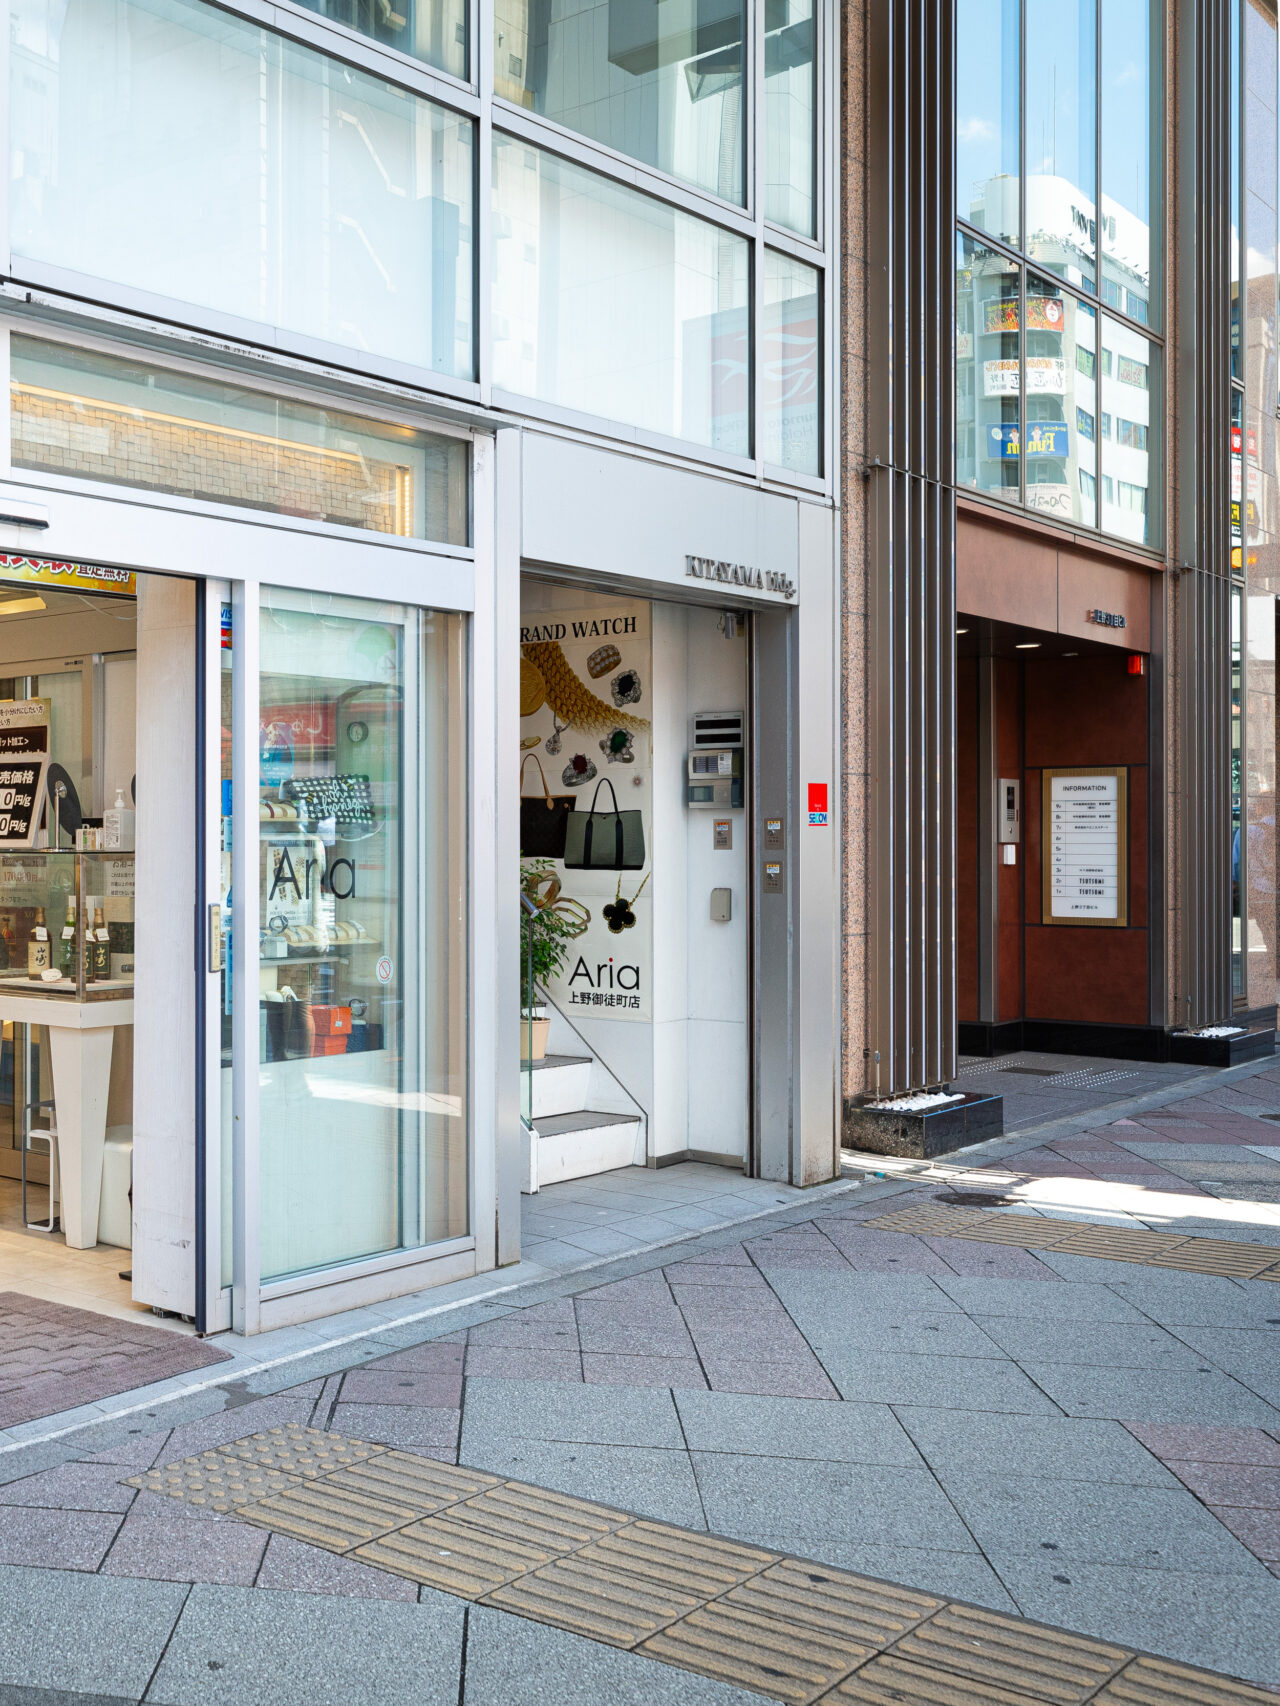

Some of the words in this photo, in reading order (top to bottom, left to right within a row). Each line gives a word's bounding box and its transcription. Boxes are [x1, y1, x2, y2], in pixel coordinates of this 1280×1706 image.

[685, 555, 764, 589] KITAYAMA
[221, 608, 232, 620] VIS
[572, 616, 637, 638] WATCH
[809, 813, 827, 823] SECOM
[568, 955, 639, 990] Aria
[568, 991, 641, 1009] 上野御徒町店
